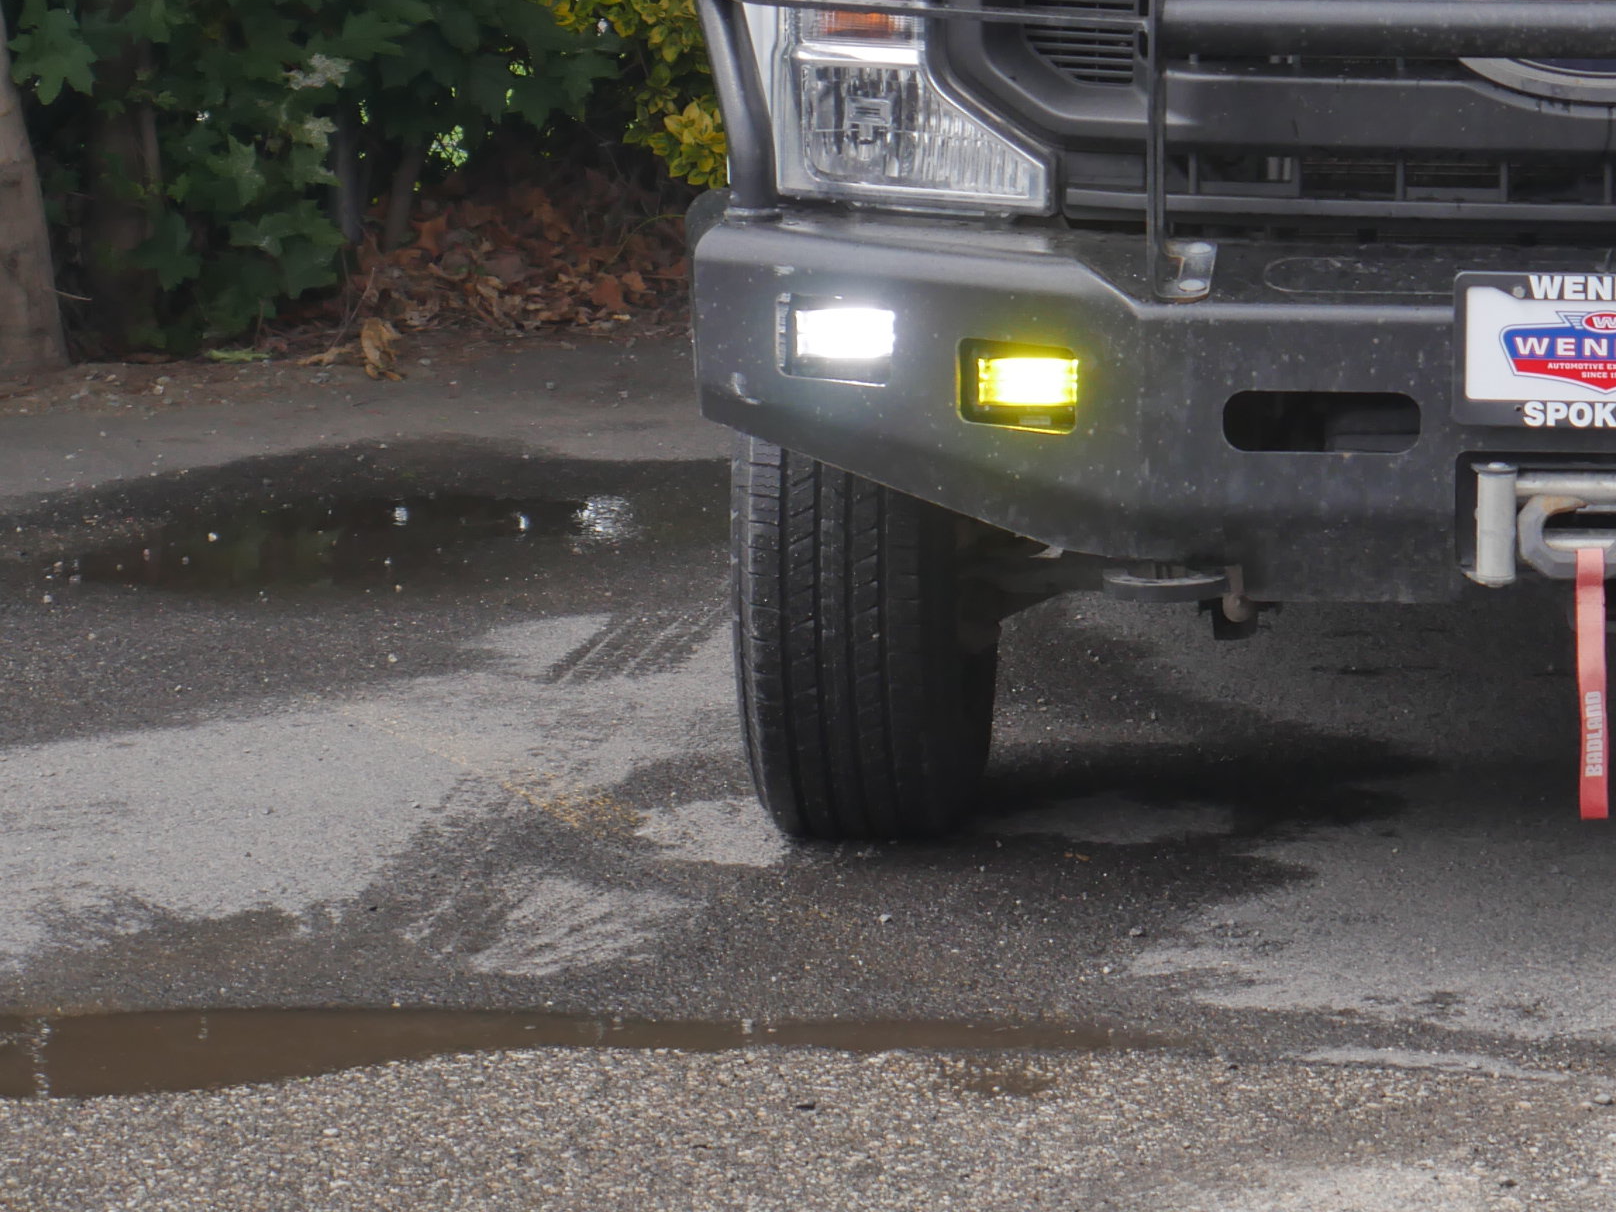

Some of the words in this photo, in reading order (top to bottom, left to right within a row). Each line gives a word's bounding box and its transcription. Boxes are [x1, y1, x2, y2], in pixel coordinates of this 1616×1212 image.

[1547, 362, 1604, 371] AUTOMOTIVE
[1581, 371, 1608, 379] SINCE
[1584, 690, 1604, 777] BADLAND
